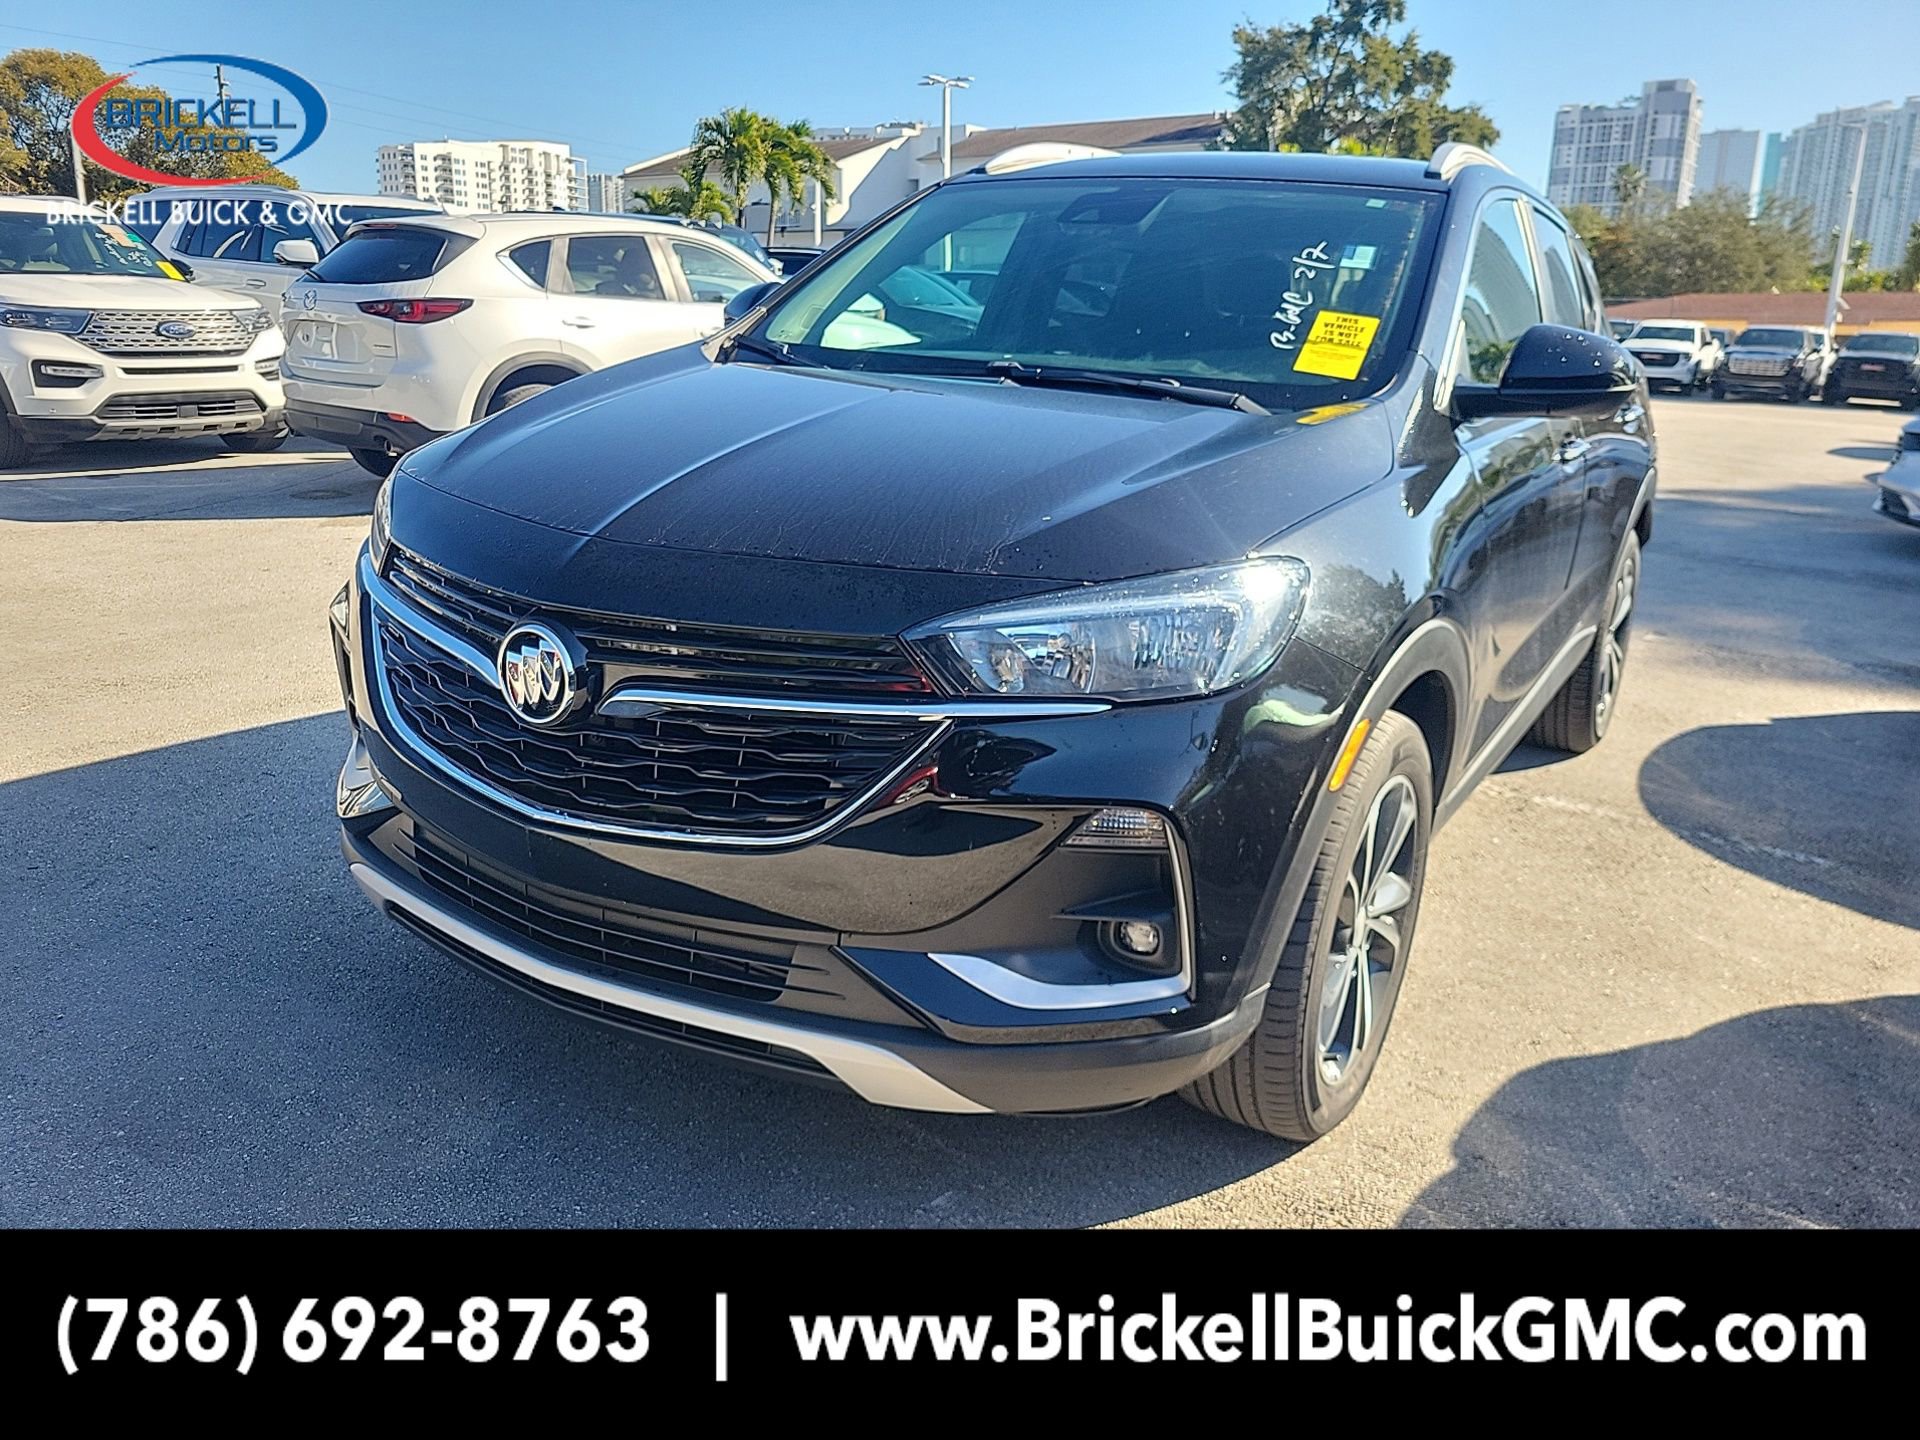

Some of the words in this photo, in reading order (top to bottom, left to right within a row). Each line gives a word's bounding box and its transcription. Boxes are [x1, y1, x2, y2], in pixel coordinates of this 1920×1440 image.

[1335, 316, 1359, 325] THIS
[1323, 322, 1365, 333] VEHICLE
[1337, 331, 1358, 340] NOT
